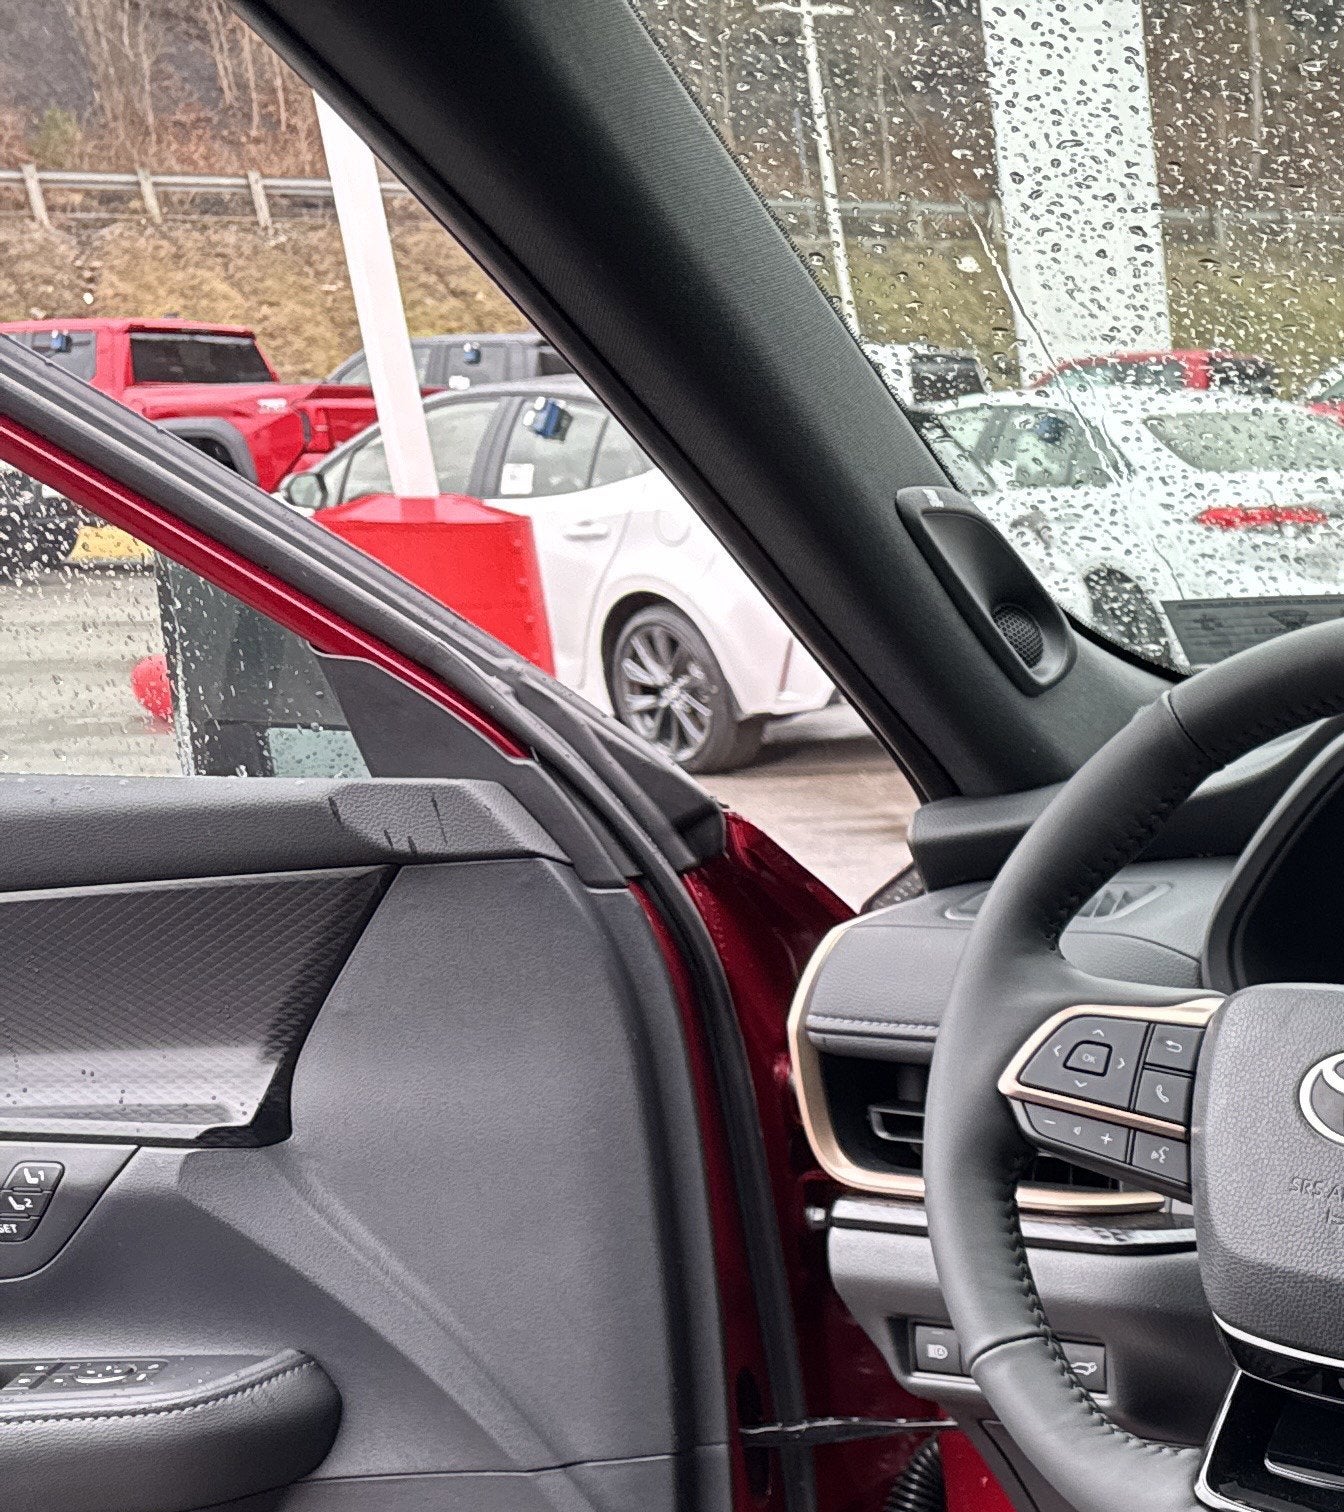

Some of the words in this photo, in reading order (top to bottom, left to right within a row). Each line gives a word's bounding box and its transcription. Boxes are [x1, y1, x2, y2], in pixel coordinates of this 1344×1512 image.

[1082, 1053, 1096, 1064] OK
[38, 1170, 45, 1181] 1
[23, 1197, 33, 1208] 2
[0, 1223, 17, 1234] SET
